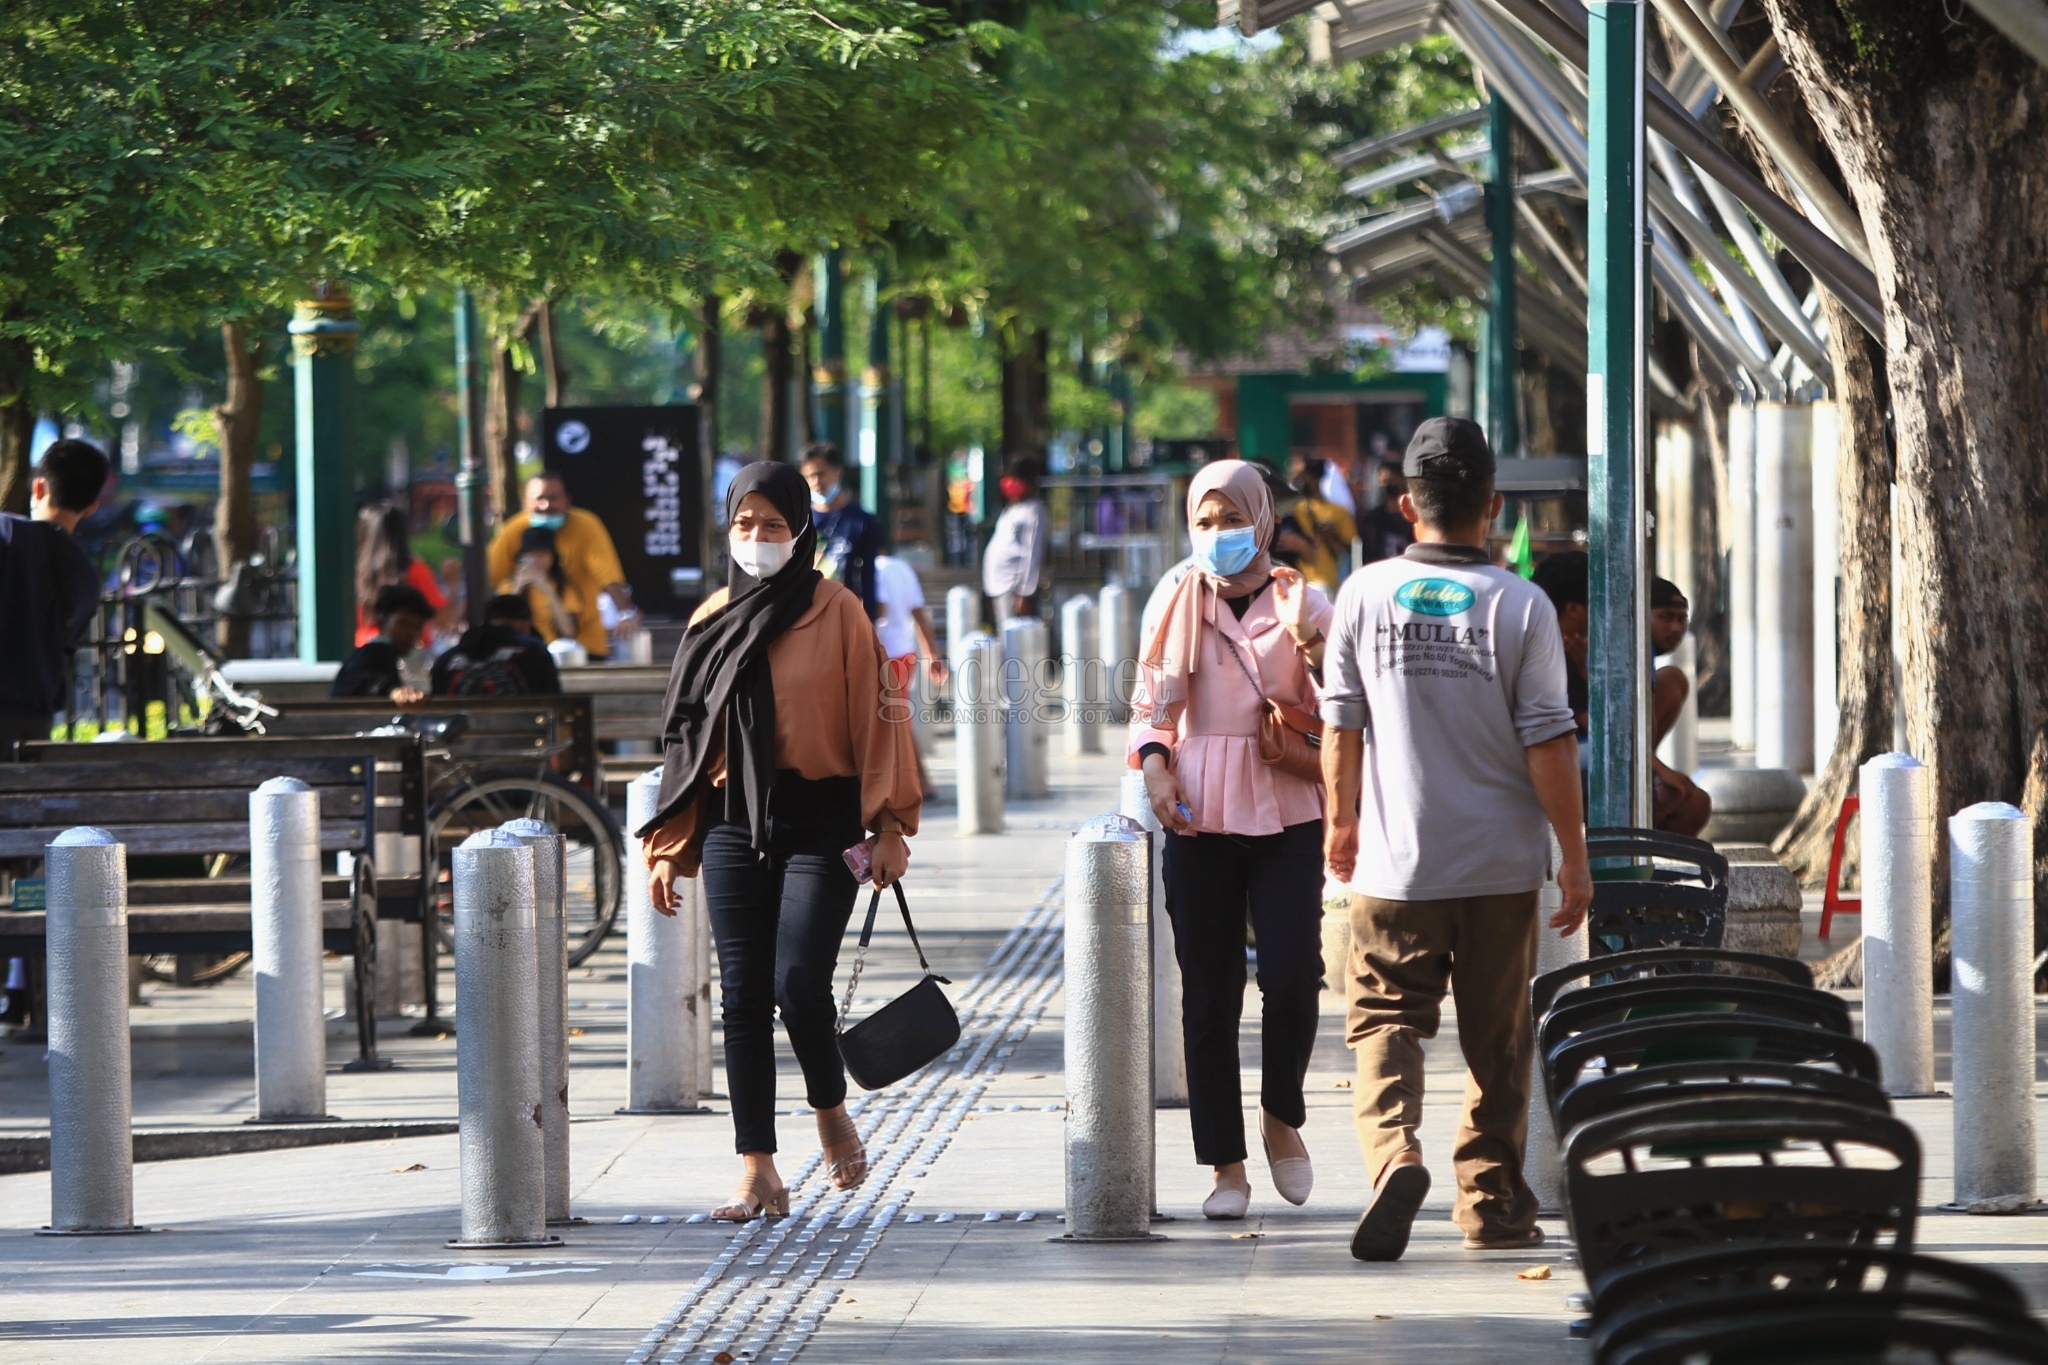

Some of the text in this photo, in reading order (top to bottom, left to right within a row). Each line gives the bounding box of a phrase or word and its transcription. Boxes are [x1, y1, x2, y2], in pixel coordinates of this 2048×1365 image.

[1401, 581, 1471, 602] Mulia
[1409, 598, 1460, 609] BUMI ARTA
[1425, 645, 1456, 653] MONEY
[1423, 652, 1447, 662] No.60
[1449, 654, 1494, 683] Yogyakarta
